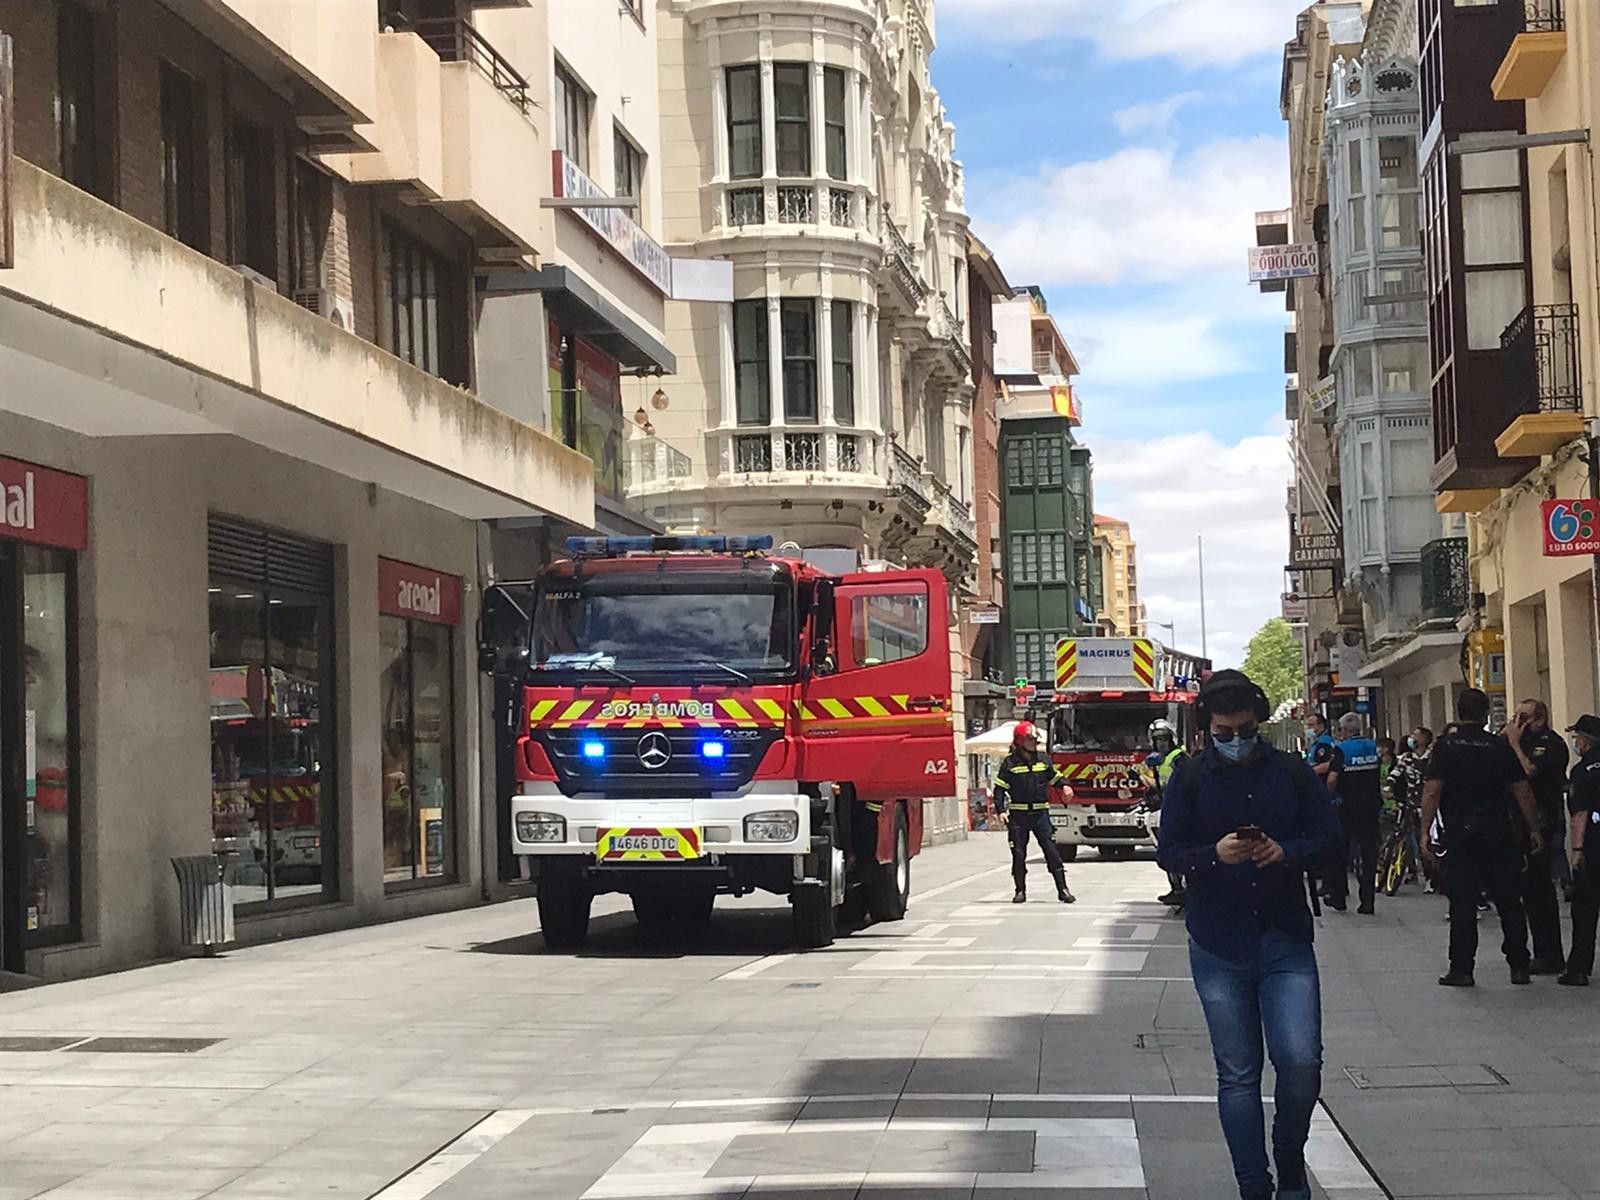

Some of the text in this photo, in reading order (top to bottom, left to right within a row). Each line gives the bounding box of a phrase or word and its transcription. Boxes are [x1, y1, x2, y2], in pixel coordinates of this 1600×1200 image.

[1299, 536, 1337, 548] TEJIDOS
[1549, 541, 1600, 552] EURO 6000
[398, 577, 440, 616] arenal
[554, 591, 582, 600] ALFA 2
[1079, 649, 1131, 657] MAGIRUS
[924, 759, 948, 775] A2
[1092, 778, 1139, 789] IVECO
[617, 837, 675, 850] 4646 DTC
